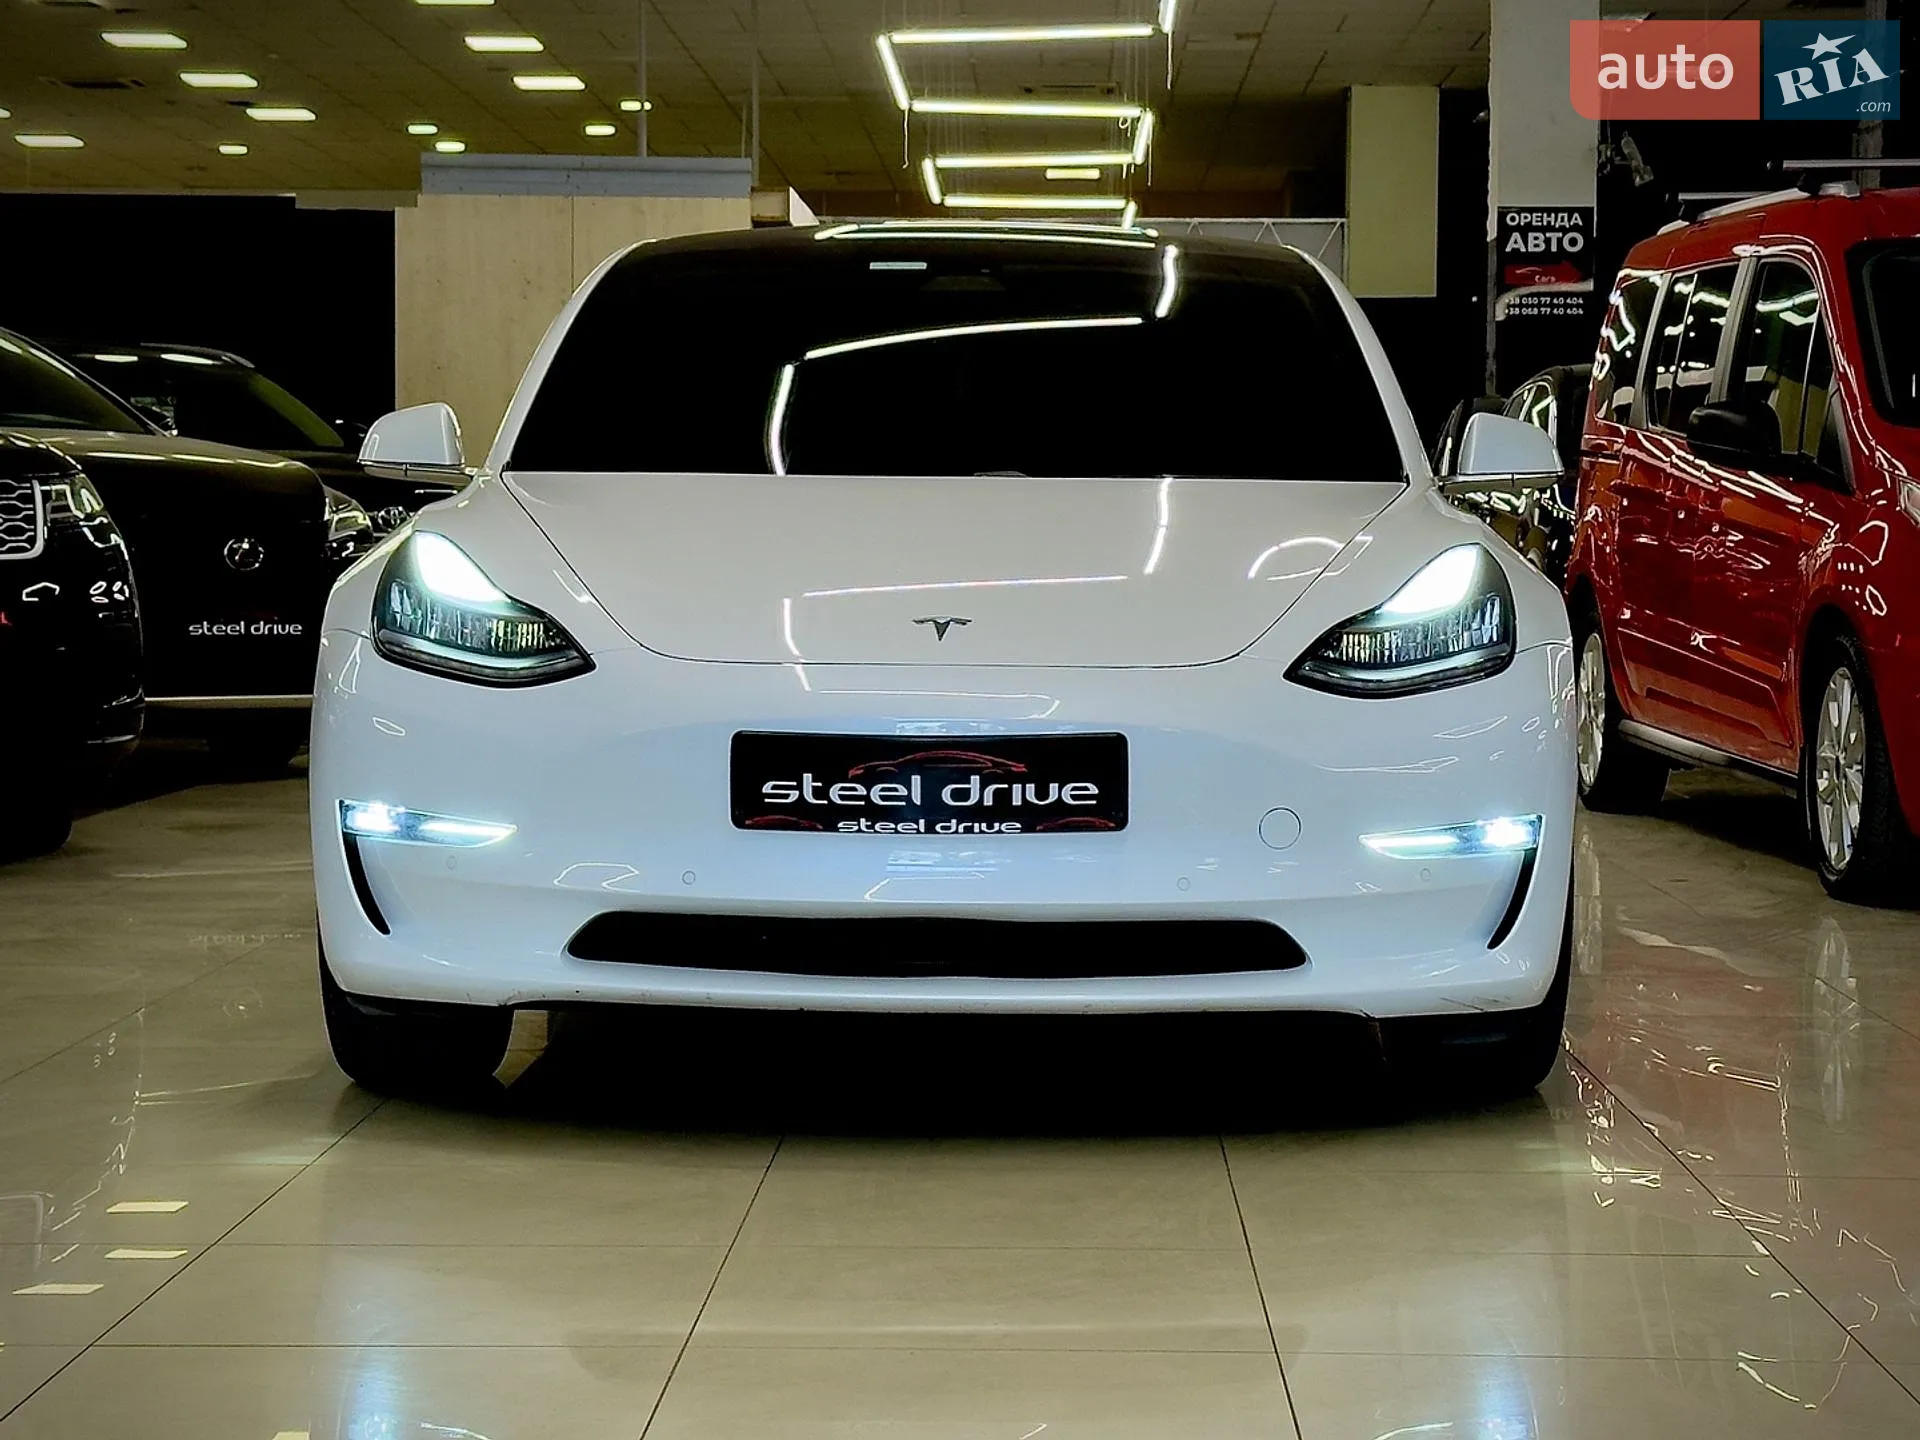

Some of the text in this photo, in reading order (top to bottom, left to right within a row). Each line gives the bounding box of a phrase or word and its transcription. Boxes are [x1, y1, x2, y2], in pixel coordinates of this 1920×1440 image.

[1506, 212, 1583, 228] ОРЕНДА
[1505, 232, 1584, 252] АВТО
[1540, 297, 1551, 305] 77
[1553, 297, 1564, 305] 40
[1566, 297, 1584, 305] 404
[1540, 307, 1551, 315] 77
[1553, 307, 1564, 315] 40
[1566, 307, 1584, 315] 404
[188, 621, 303, 635] steel drive
[761, 773, 1100, 807] steel drive
[837, 819, 1022, 834] steel drive
